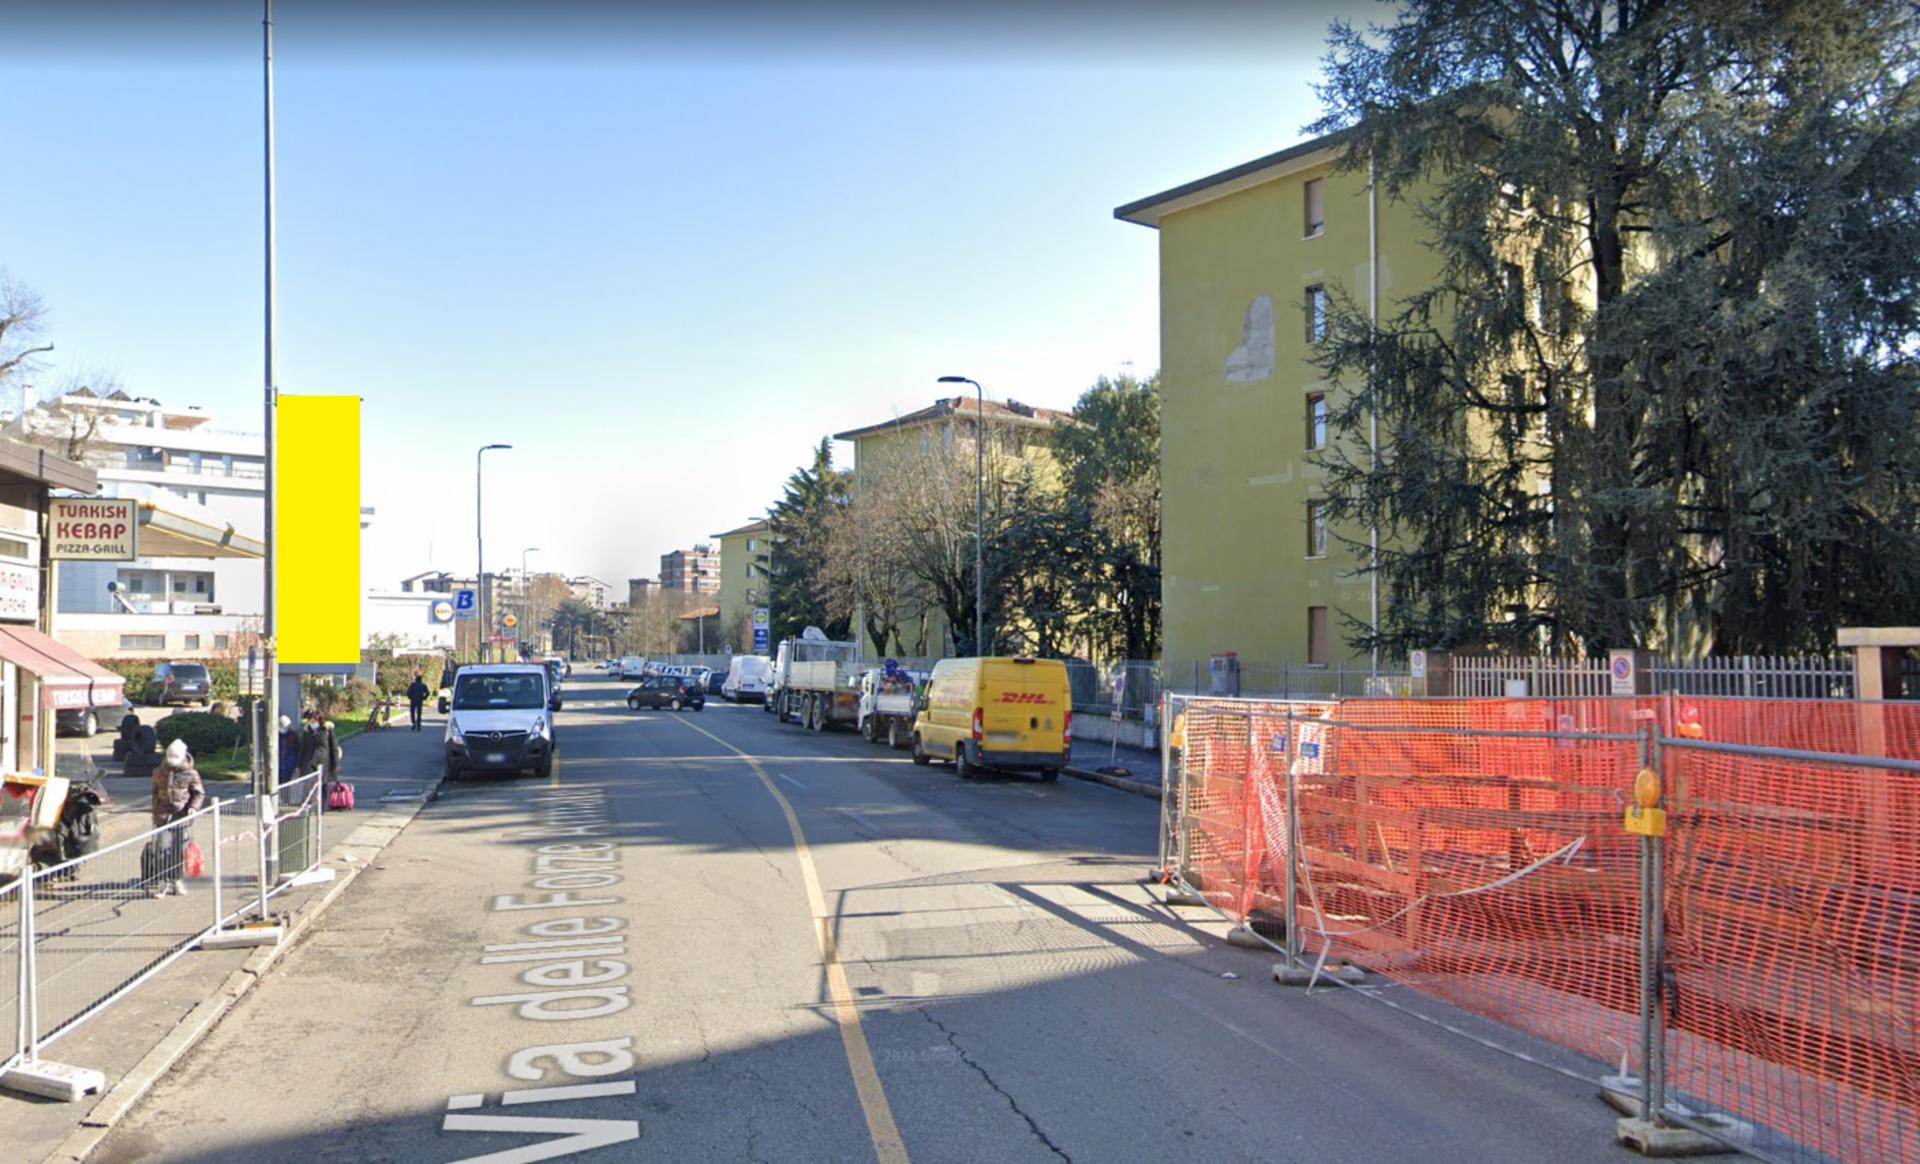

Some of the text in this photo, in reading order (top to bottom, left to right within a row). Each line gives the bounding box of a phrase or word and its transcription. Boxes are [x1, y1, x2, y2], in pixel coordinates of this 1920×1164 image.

[57, 504, 128, 519] TURKISH
[56, 522, 127, 539] KEBAP
[56, 543, 127, 554] PIZZA-GRILL
[1000, 692, 1047, 705] DHL
